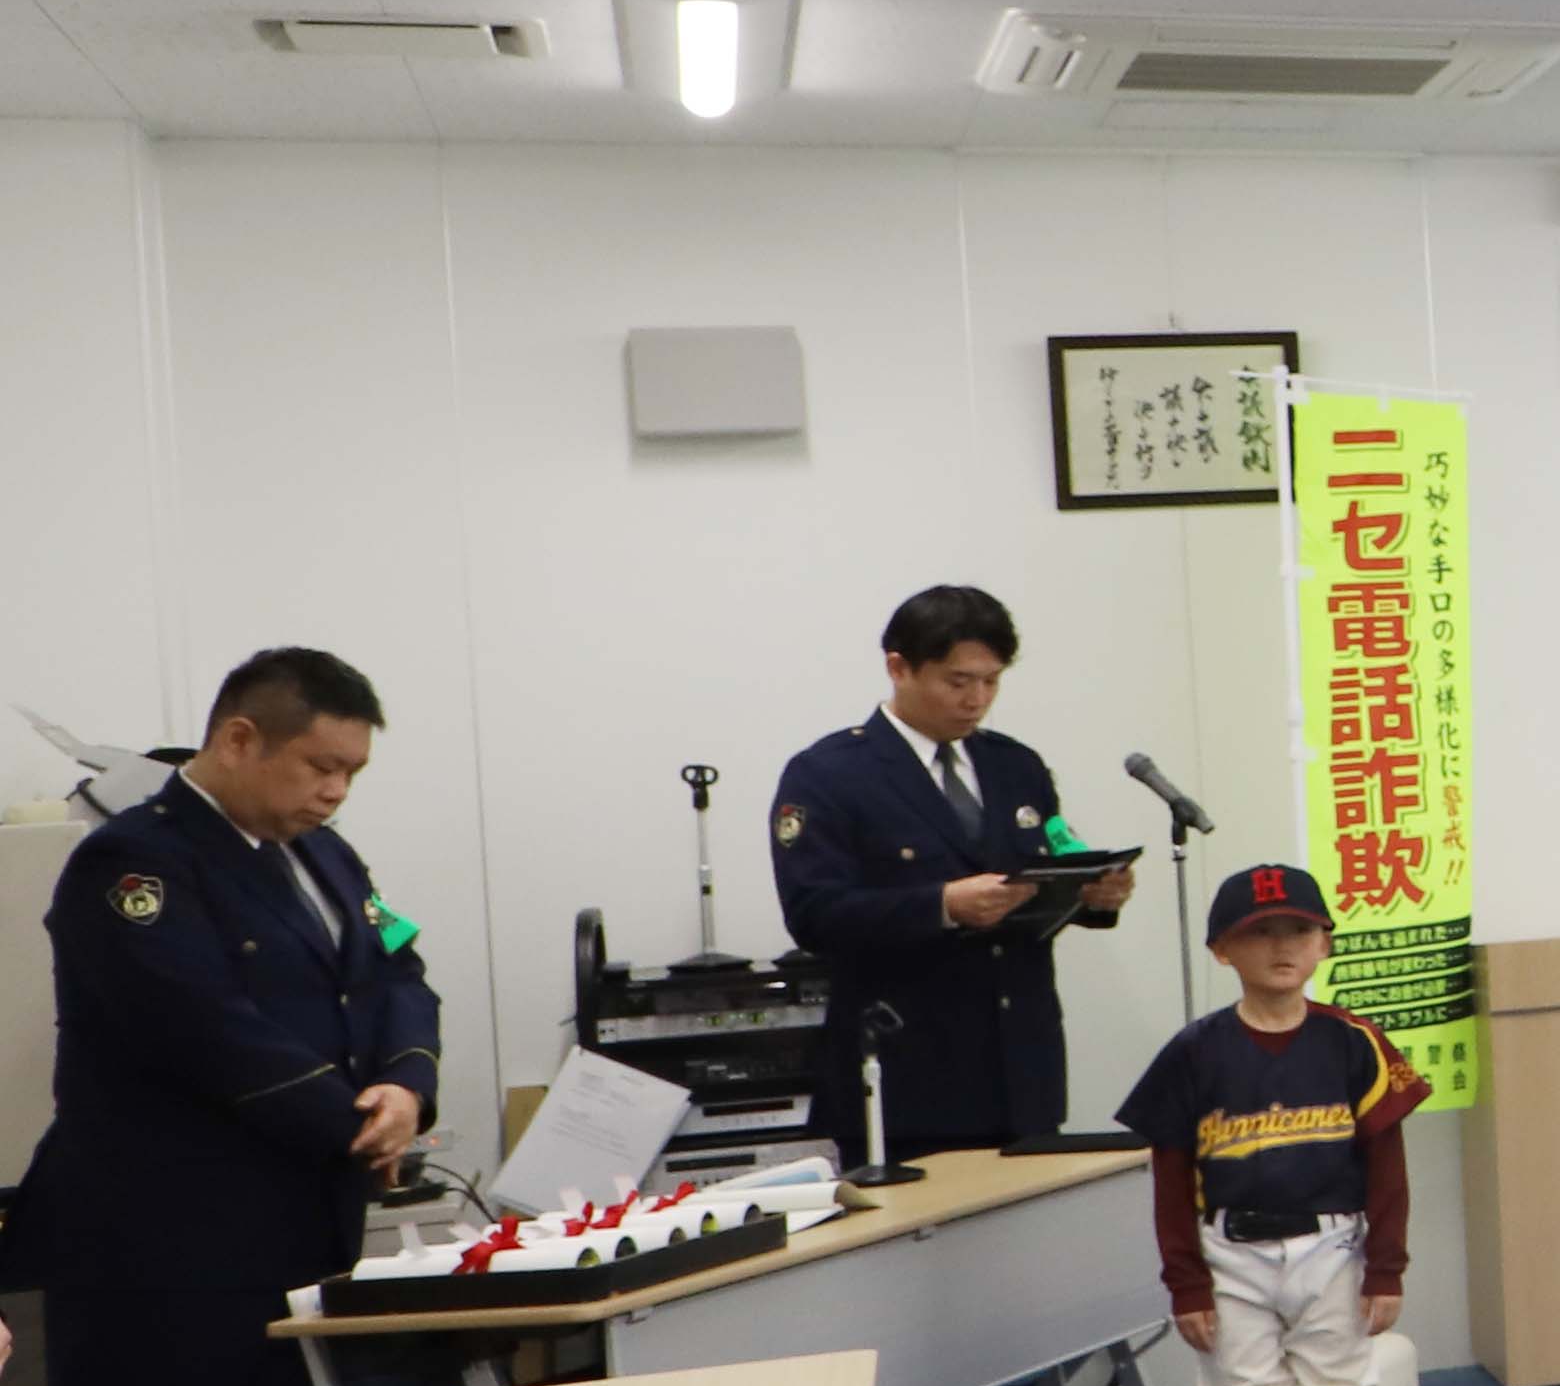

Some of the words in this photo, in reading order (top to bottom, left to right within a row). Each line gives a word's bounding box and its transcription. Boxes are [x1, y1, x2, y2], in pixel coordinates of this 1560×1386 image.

[1327, 429, 1425, 913] ニセ電話詐欺
[1252, 869, 1287, 903] H
